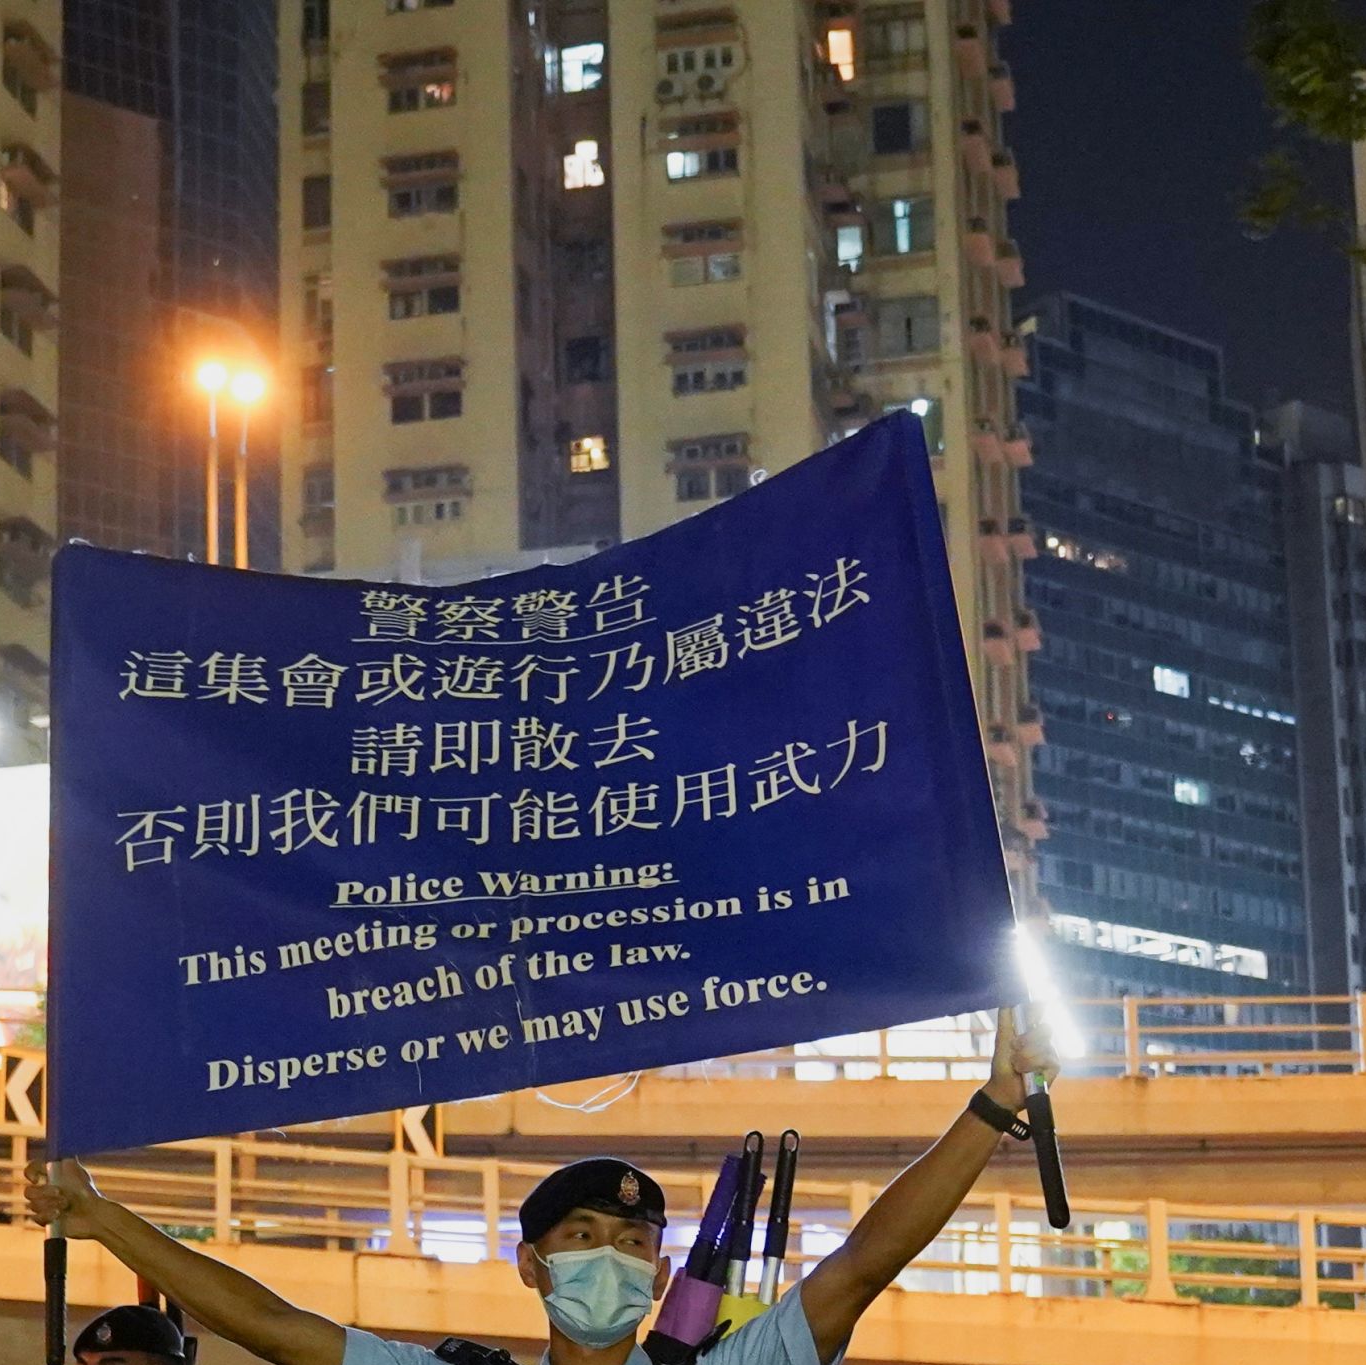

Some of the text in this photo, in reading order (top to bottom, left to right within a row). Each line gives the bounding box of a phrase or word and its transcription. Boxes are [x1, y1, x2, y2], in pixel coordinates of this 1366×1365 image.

[118, 556, 870, 708] 這集會或遊行乃屬違法
[360, 575, 653, 640] 警察警告
[350, 713, 660, 777] 請即散去
[115, 718, 889, 872] 否則我們可能使用武力
[335, 862, 674, 905] Police Warning:
[178, 876, 851, 986] This meeting or procession is in
[325, 943, 691, 1019] breach of the law.
[205, 971, 828, 1092] Disperse or we may use force.
